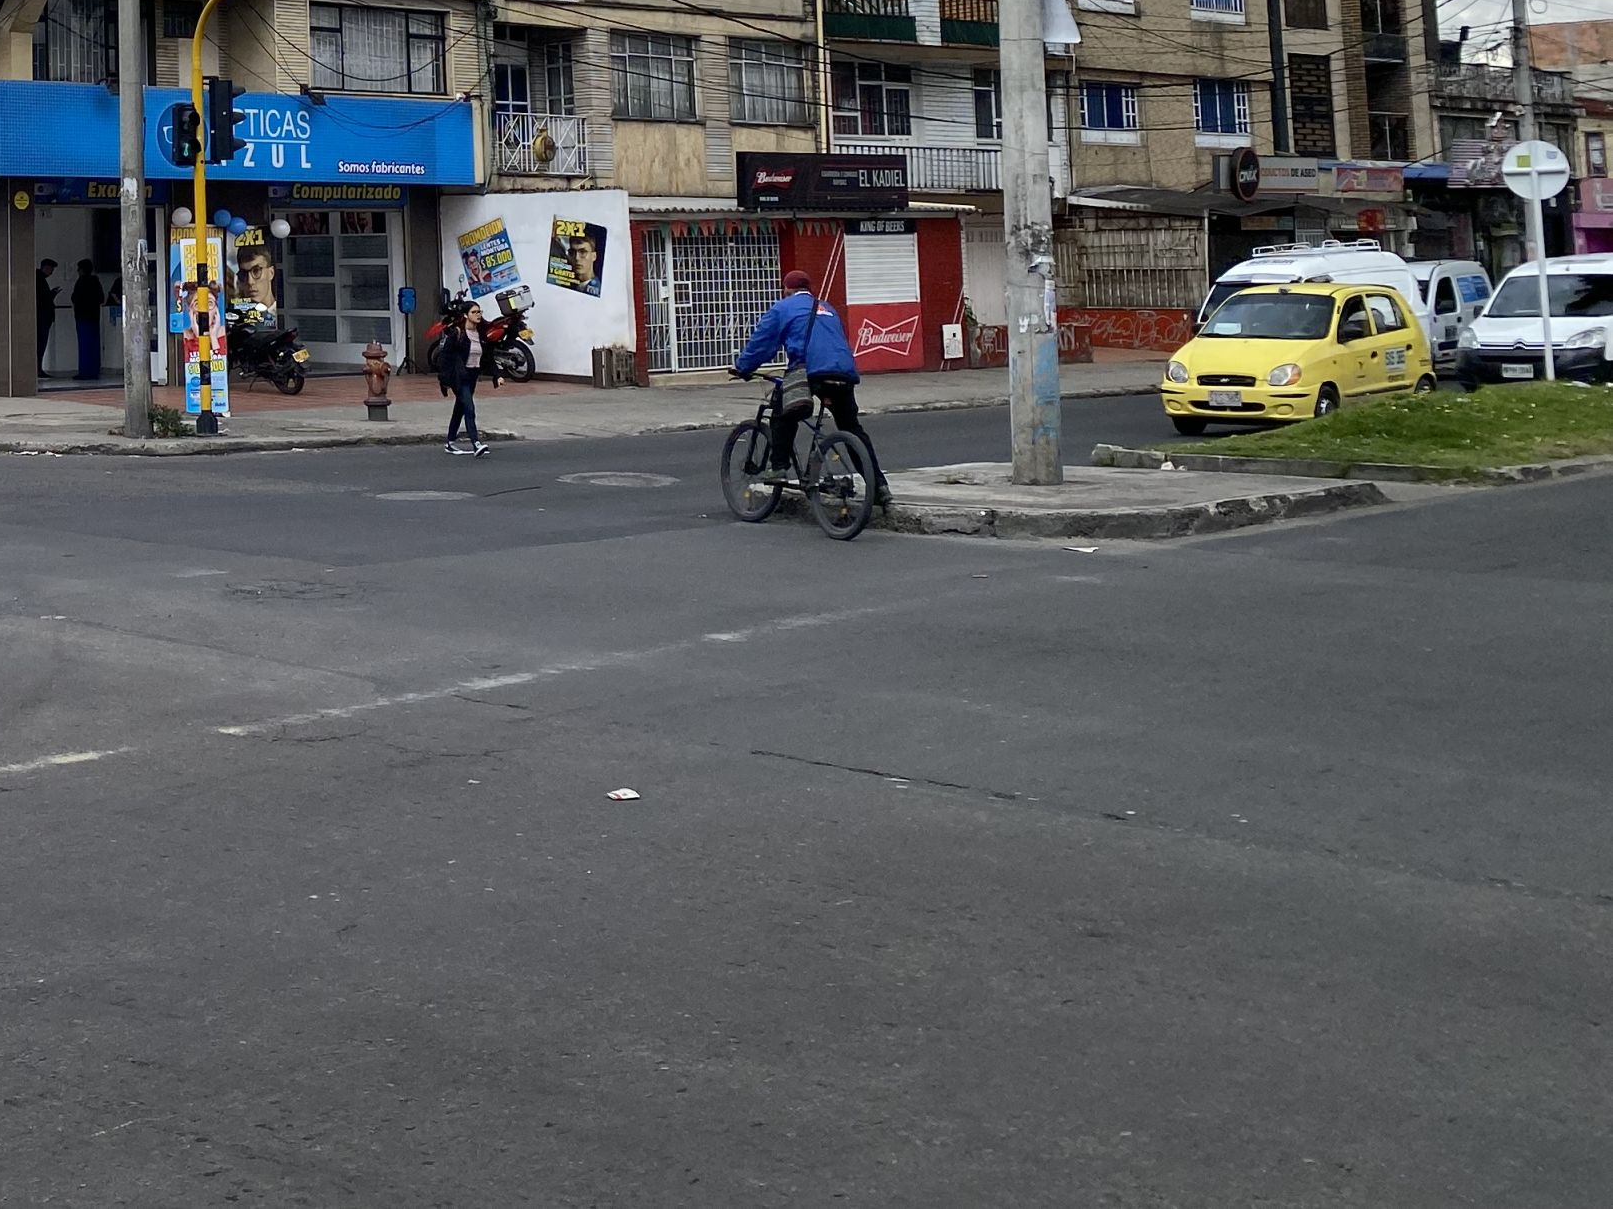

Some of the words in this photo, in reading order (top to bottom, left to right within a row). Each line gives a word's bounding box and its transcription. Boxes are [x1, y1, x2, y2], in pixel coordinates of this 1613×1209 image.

[231, 108, 311, 140] PTICAS
[219, 143, 312, 170] ZUL
[338, 160, 370, 174] Somos
[371, 161, 425, 175] fabricantes
[1290, 167, 1299, 177] DE
[1300, 167, 1317, 178] ASEO
[756, 171, 793, 184] Budweiser
[858, 170, 871, 188] EL
[872, 170, 906, 188] KADIEL
[87, 181, 153, 199] Exan
[292, 183, 402, 202] Computarizado
[555, 220, 586, 238] 2X1
[859, 220, 877, 233] KING
[877, 220, 885, 233] OF
[885, 220, 905, 233] BEERS
[858, 327, 914, 347] Budweiser
